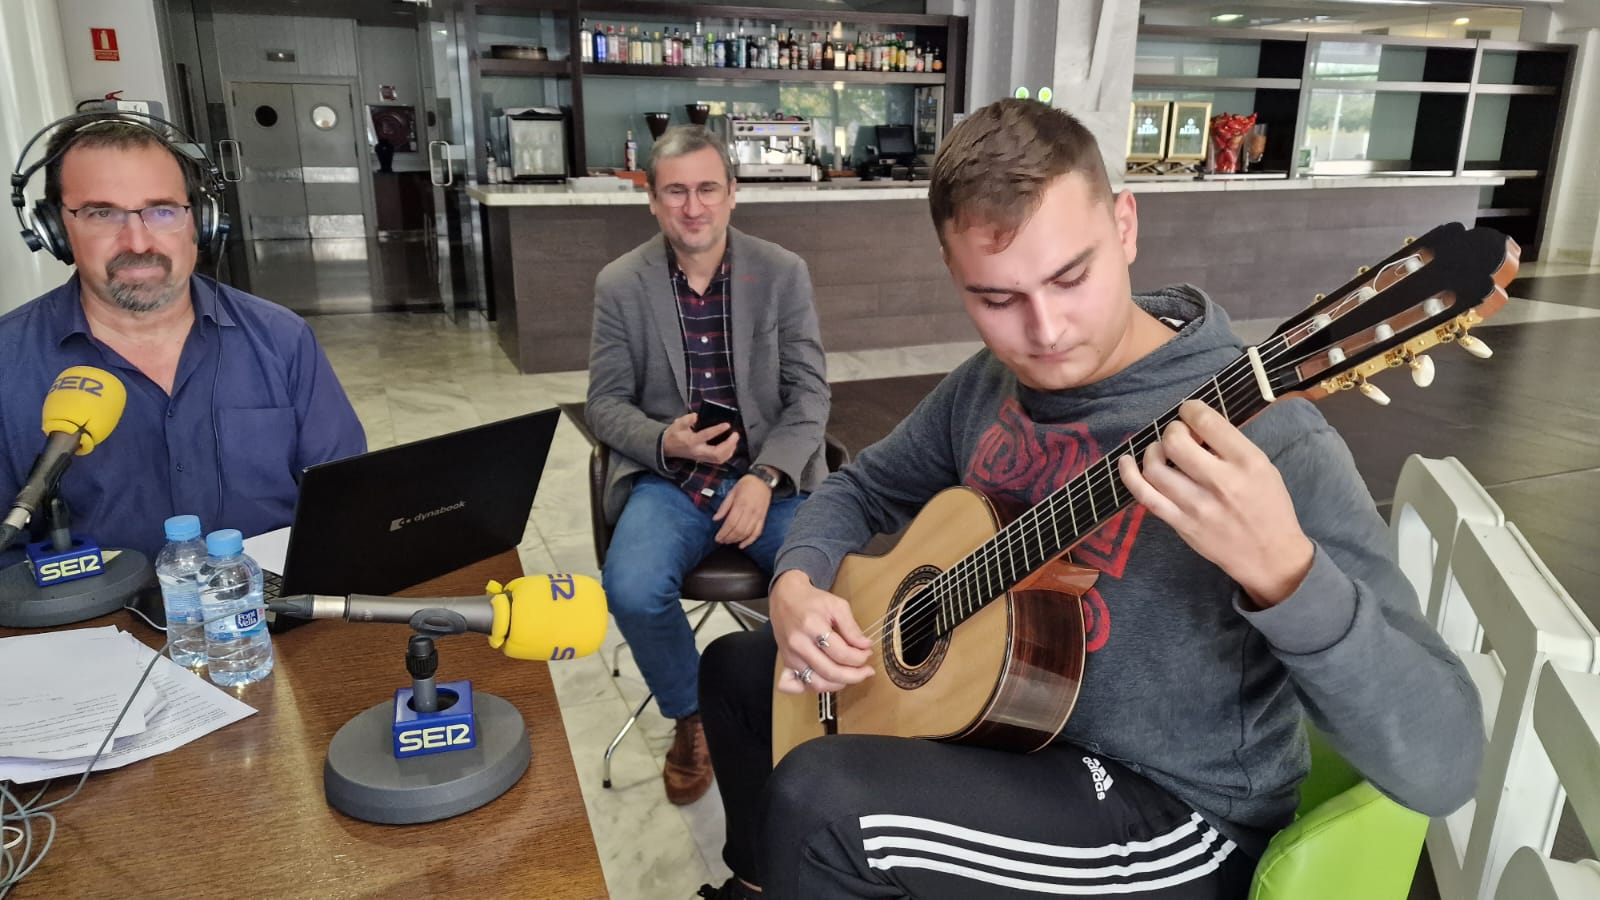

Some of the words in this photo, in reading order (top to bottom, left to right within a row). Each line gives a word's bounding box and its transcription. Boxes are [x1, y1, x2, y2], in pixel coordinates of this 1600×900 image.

[414, 500, 467, 521] dynabook
[40, 555, 101, 581] SER
[398, 723, 471, 752] SER
[1082, 756, 1106, 801] adidas
